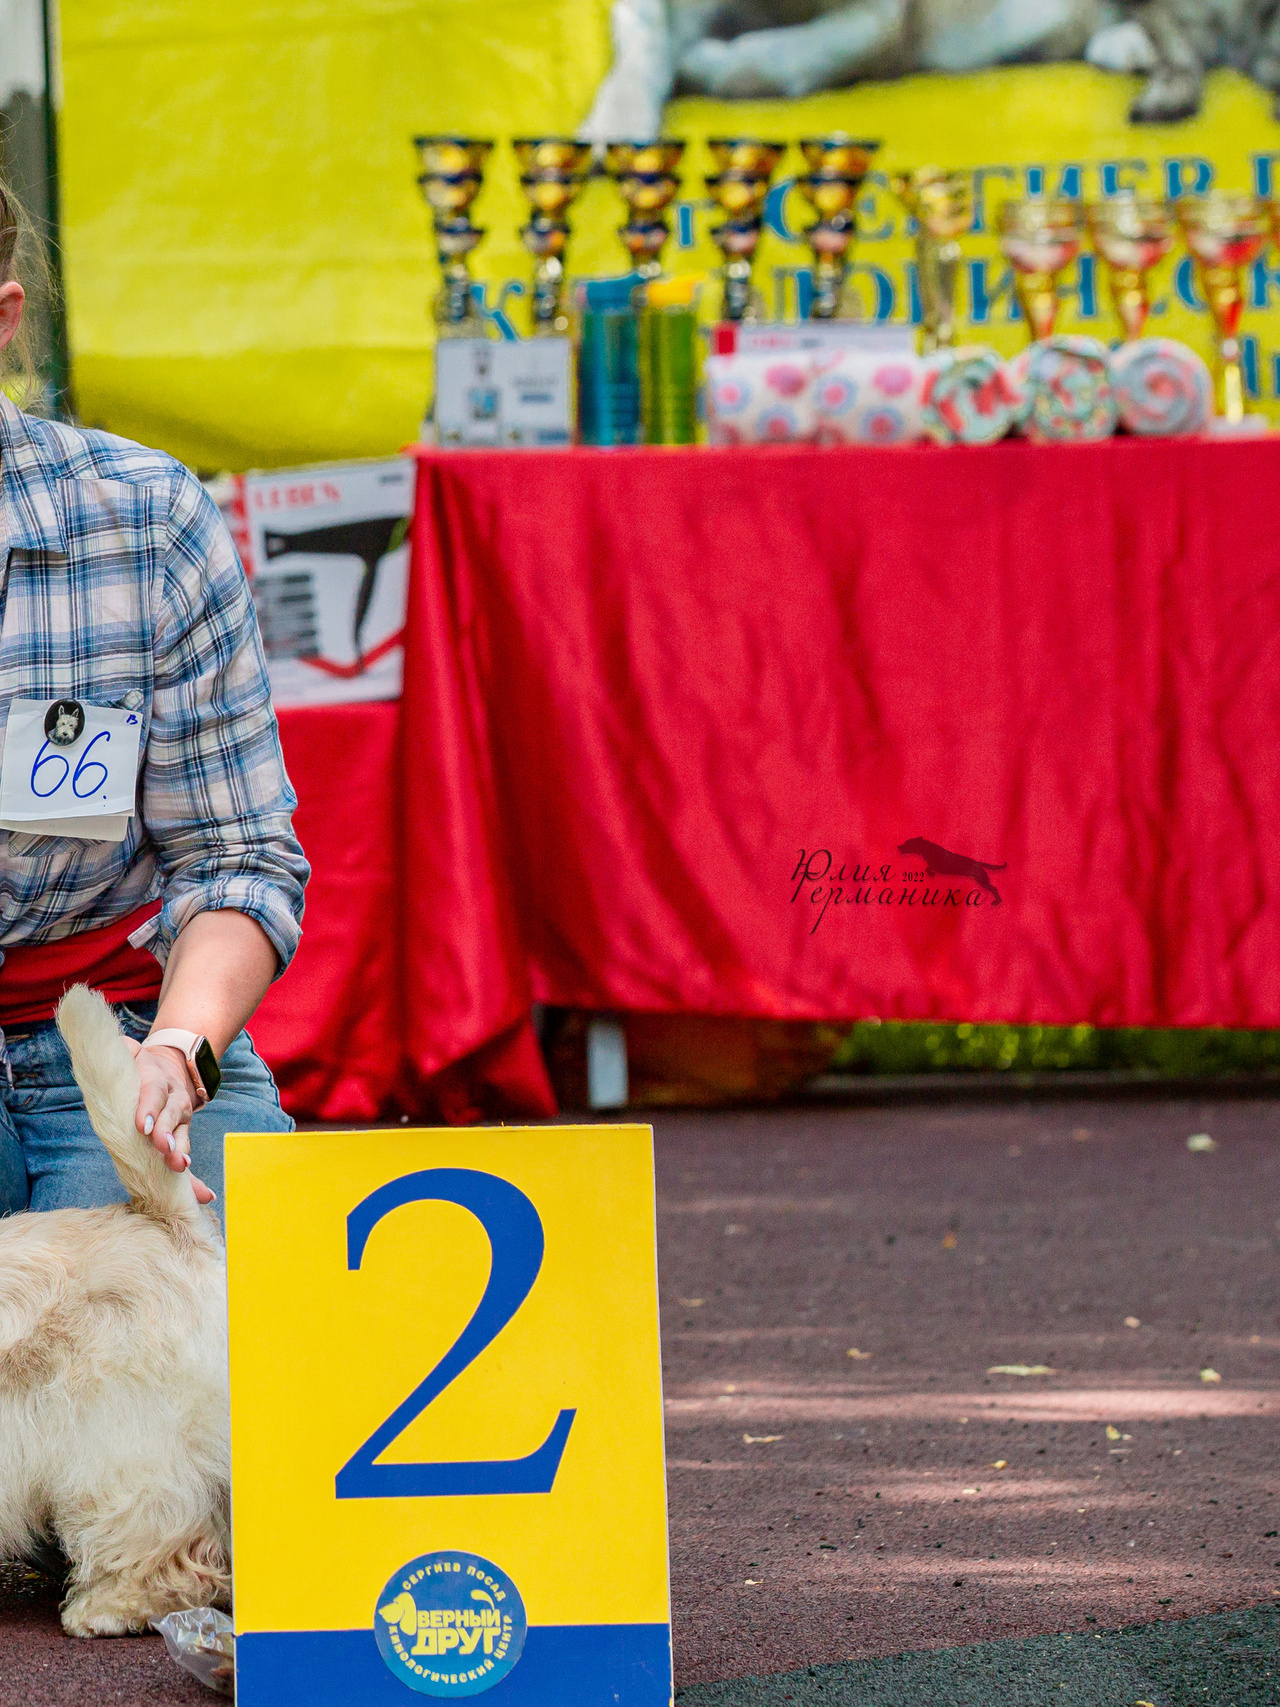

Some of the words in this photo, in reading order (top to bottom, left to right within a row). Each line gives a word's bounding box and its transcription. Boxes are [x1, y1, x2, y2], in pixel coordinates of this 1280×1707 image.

[334, 1167, 578, 1500] 2
[402, 1562, 461, 1591] СЕРГИЕВ
[466, 1565, 507, 1602] ПОСАД
[388, 1624, 495, 1684] КИНОЛОГИЧЕСКИЙ
[493, 1614, 513, 1660] ЦЕНТР
[410, 1627, 502, 1656] ДРУГ
